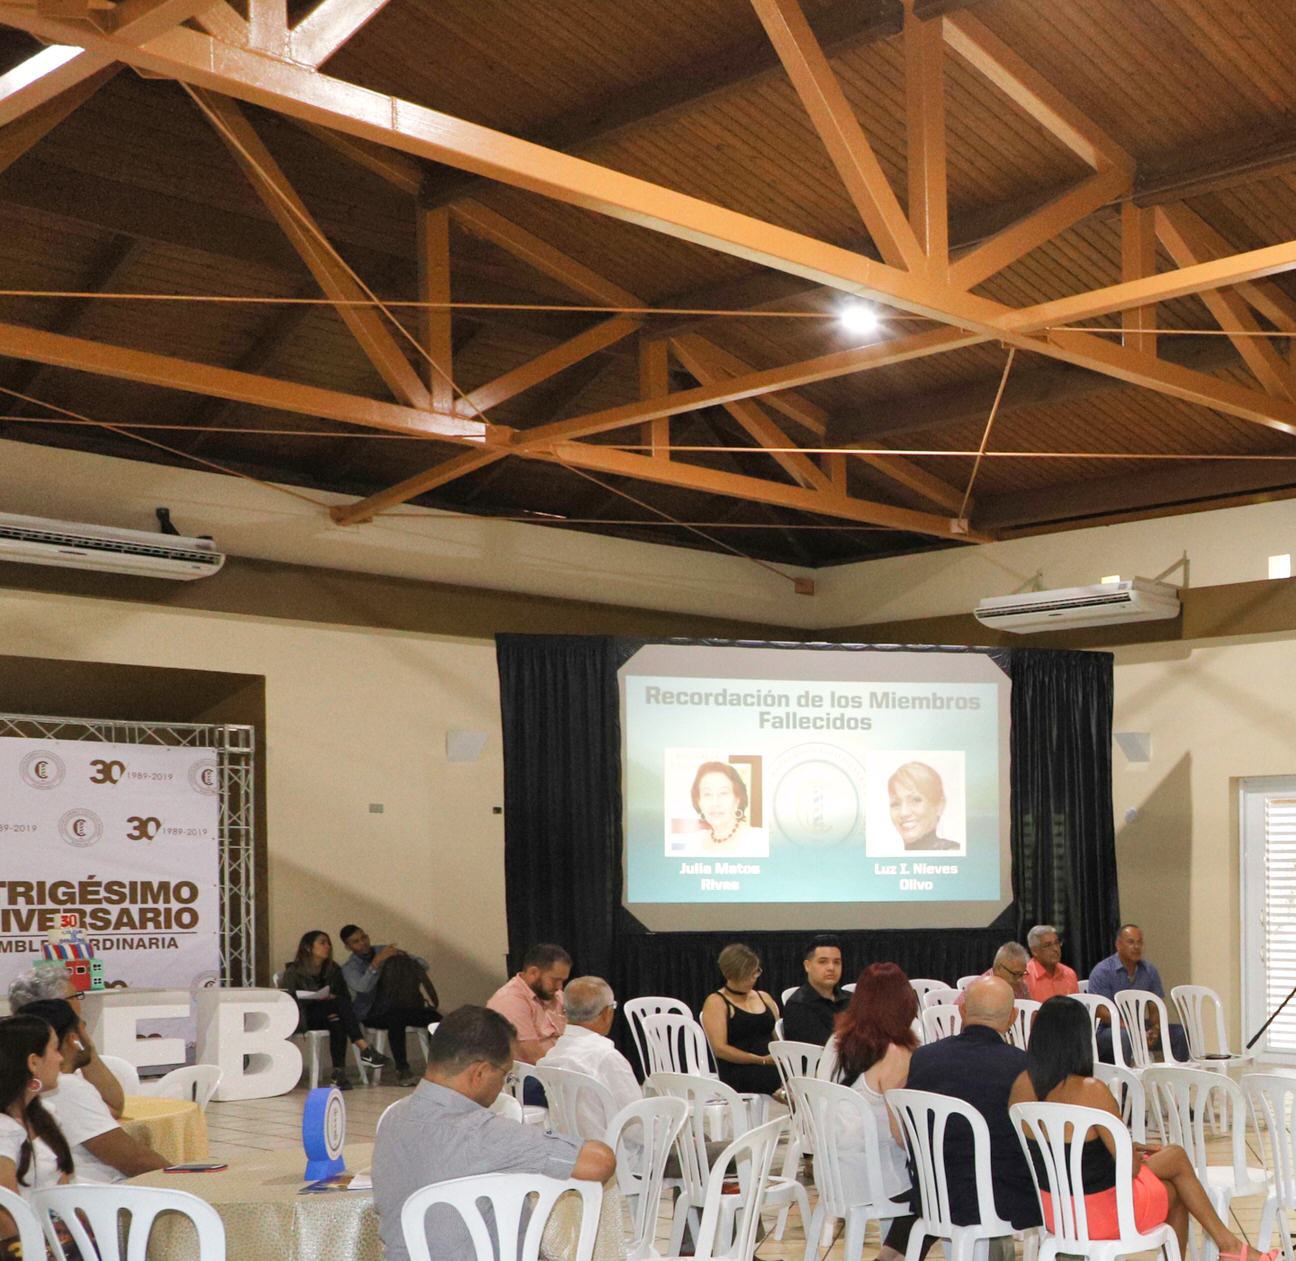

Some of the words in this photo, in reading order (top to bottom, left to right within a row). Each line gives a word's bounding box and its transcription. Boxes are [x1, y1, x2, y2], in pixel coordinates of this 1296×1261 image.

[645, 686, 790, 707] Recordación
[796, 691, 824, 708] de
[830, 691, 863, 709] los
[869, 691, 981, 710] Miembros
[759, 711, 872, 730] Fallecidos
[89, 759, 126, 785] 30
[127, 772, 173, 781] 1989-2019
[126, 816, 162, 841] 30
[162, 828, 208, 836] 1989-2019
[715, 862, 761, 874] Matos
[875, 863, 897, 874] Luz
[913, 863, 958, 874] Nieves
[900, 879, 933, 890] Olivo
[0, 907, 199, 932] IVERSARIO
[61, 914, 77, 927] 30
[88, 937, 178, 951] RDINARIA
